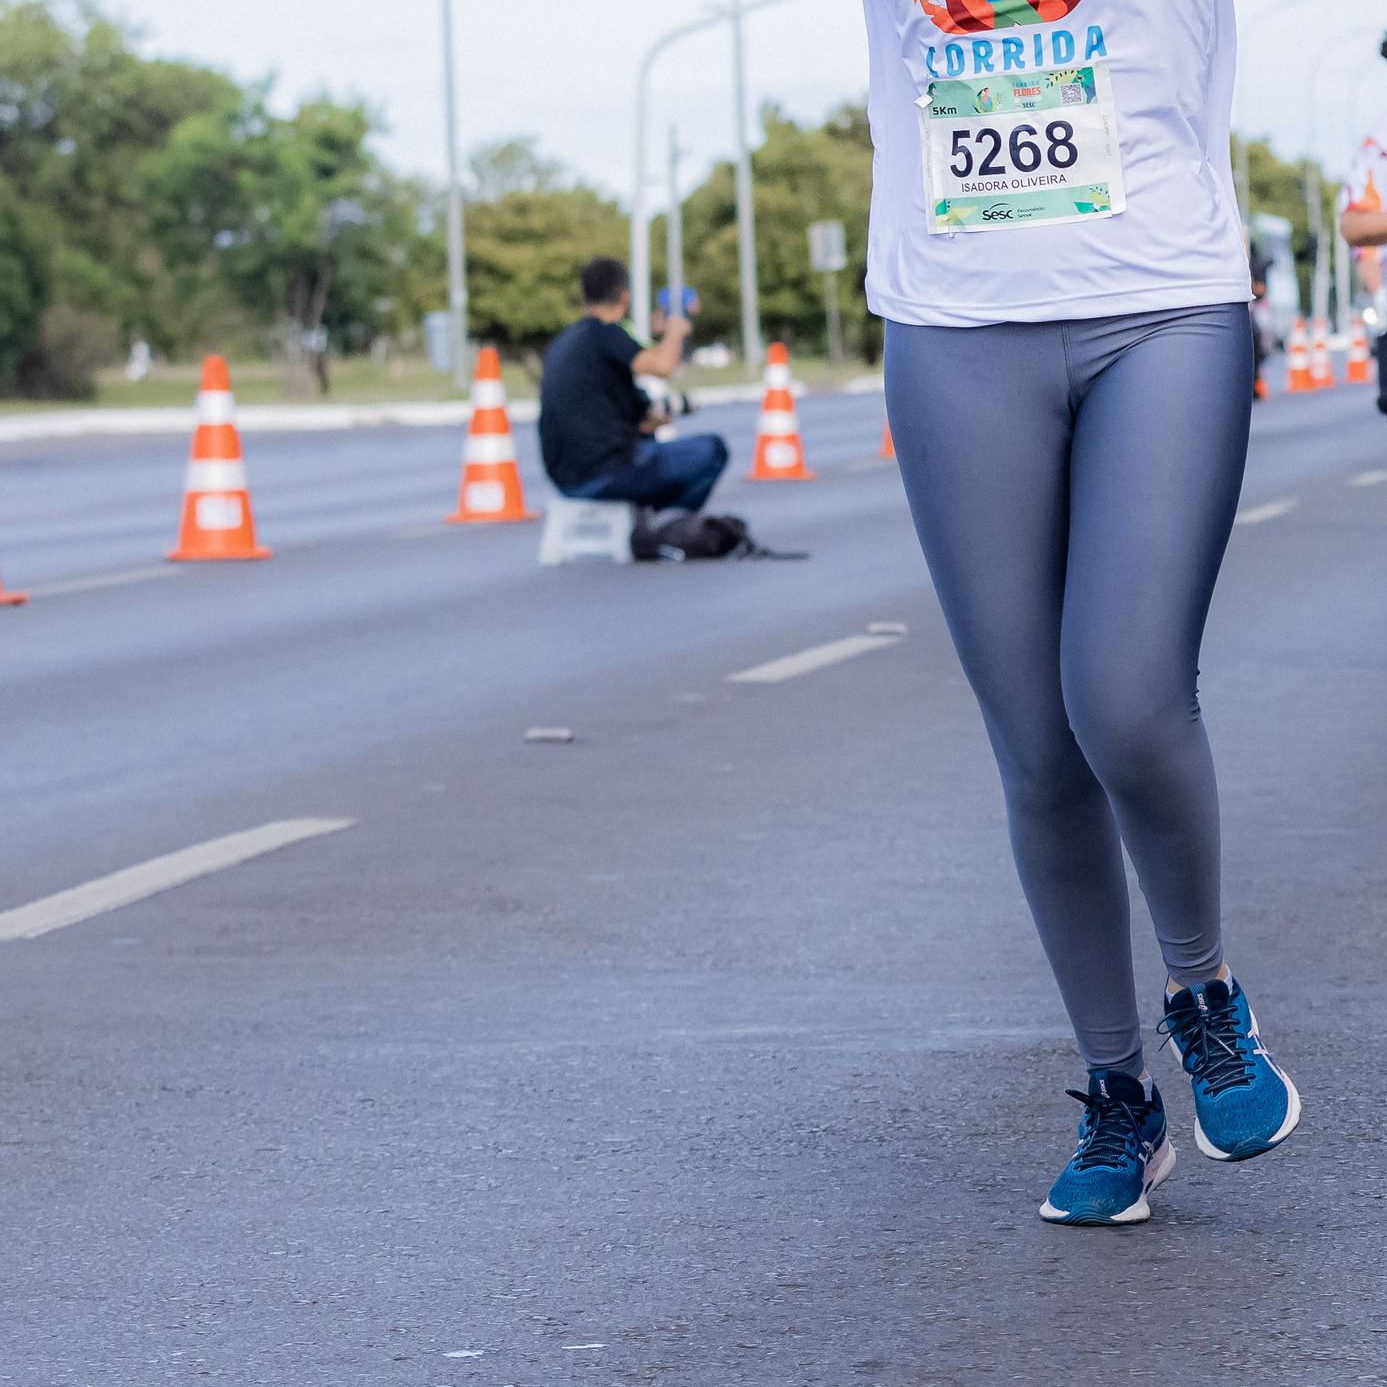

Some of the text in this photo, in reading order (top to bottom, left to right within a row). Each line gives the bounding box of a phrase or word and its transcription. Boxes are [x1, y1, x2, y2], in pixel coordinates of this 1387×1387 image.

[1013, 86, 1041, 98] FLORES
[932, 106, 957, 116] 5Km
[950, 120, 1078, 178] 5268
[961, 174, 1068, 193] ISADORA OLIVEIRA
[982, 209, 1014, 221] Sesc
